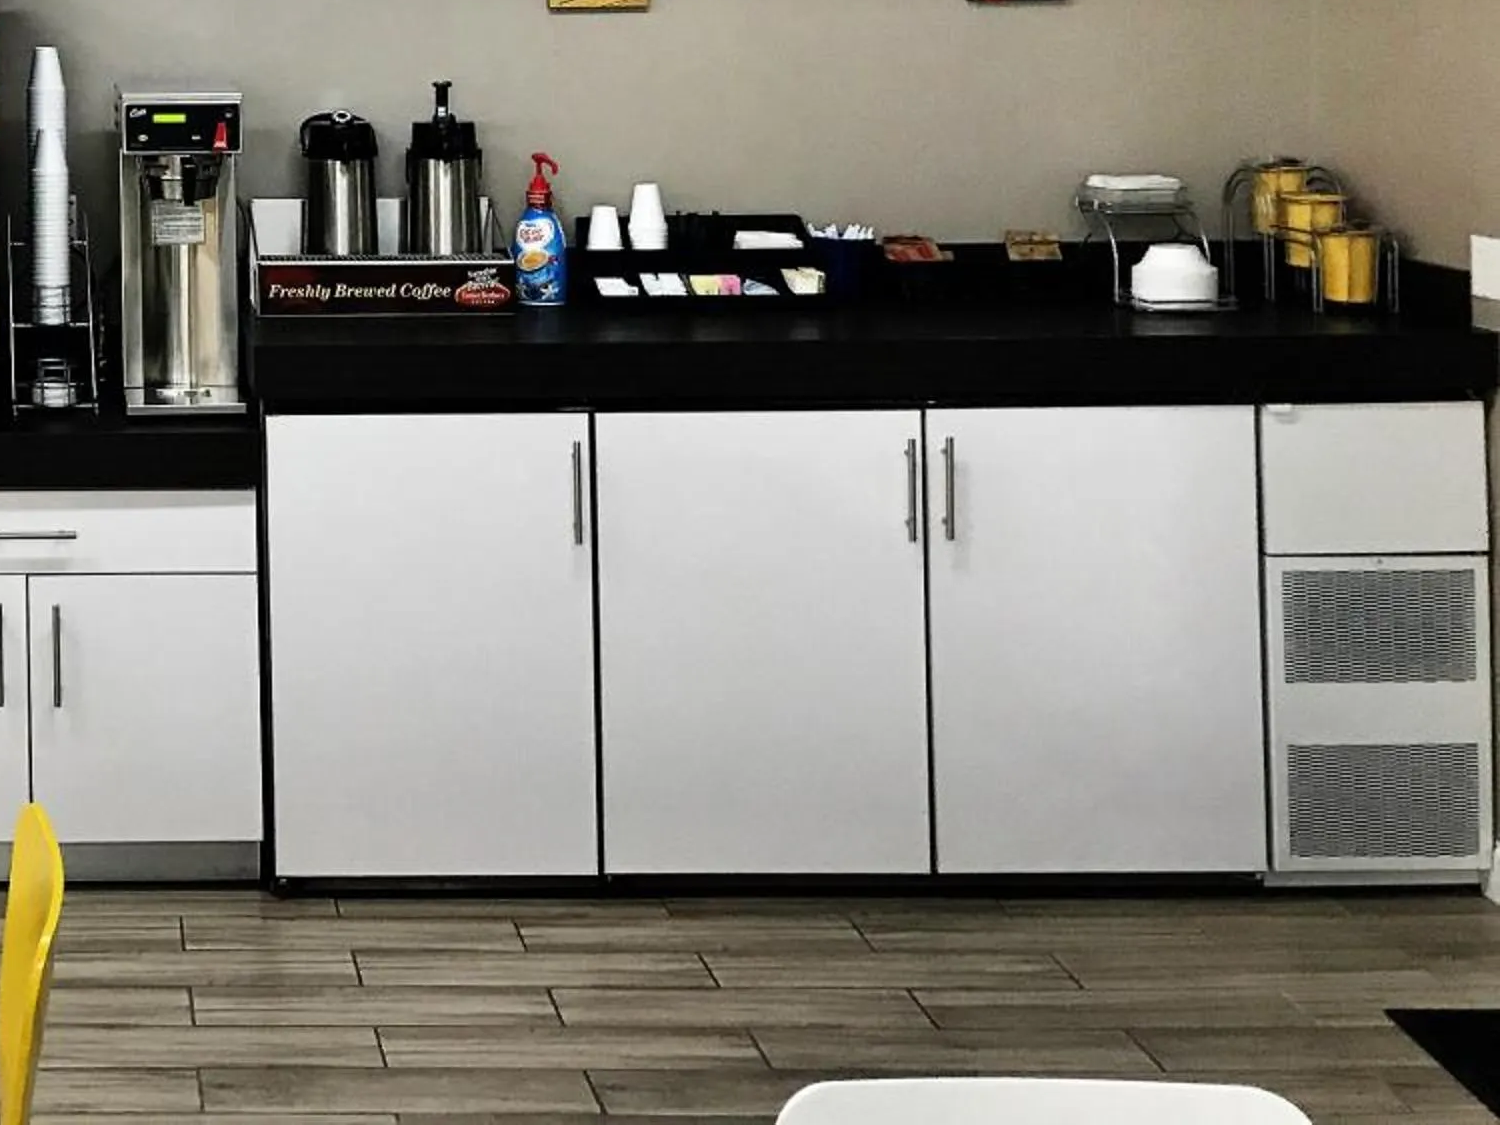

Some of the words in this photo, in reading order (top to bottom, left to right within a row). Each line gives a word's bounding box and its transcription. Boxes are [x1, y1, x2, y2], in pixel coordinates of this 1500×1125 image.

[268, 284, 331, 301] Freshly
[334, 283, 397, 298] Brewed
[400, 283, 452, 300] Coffee
